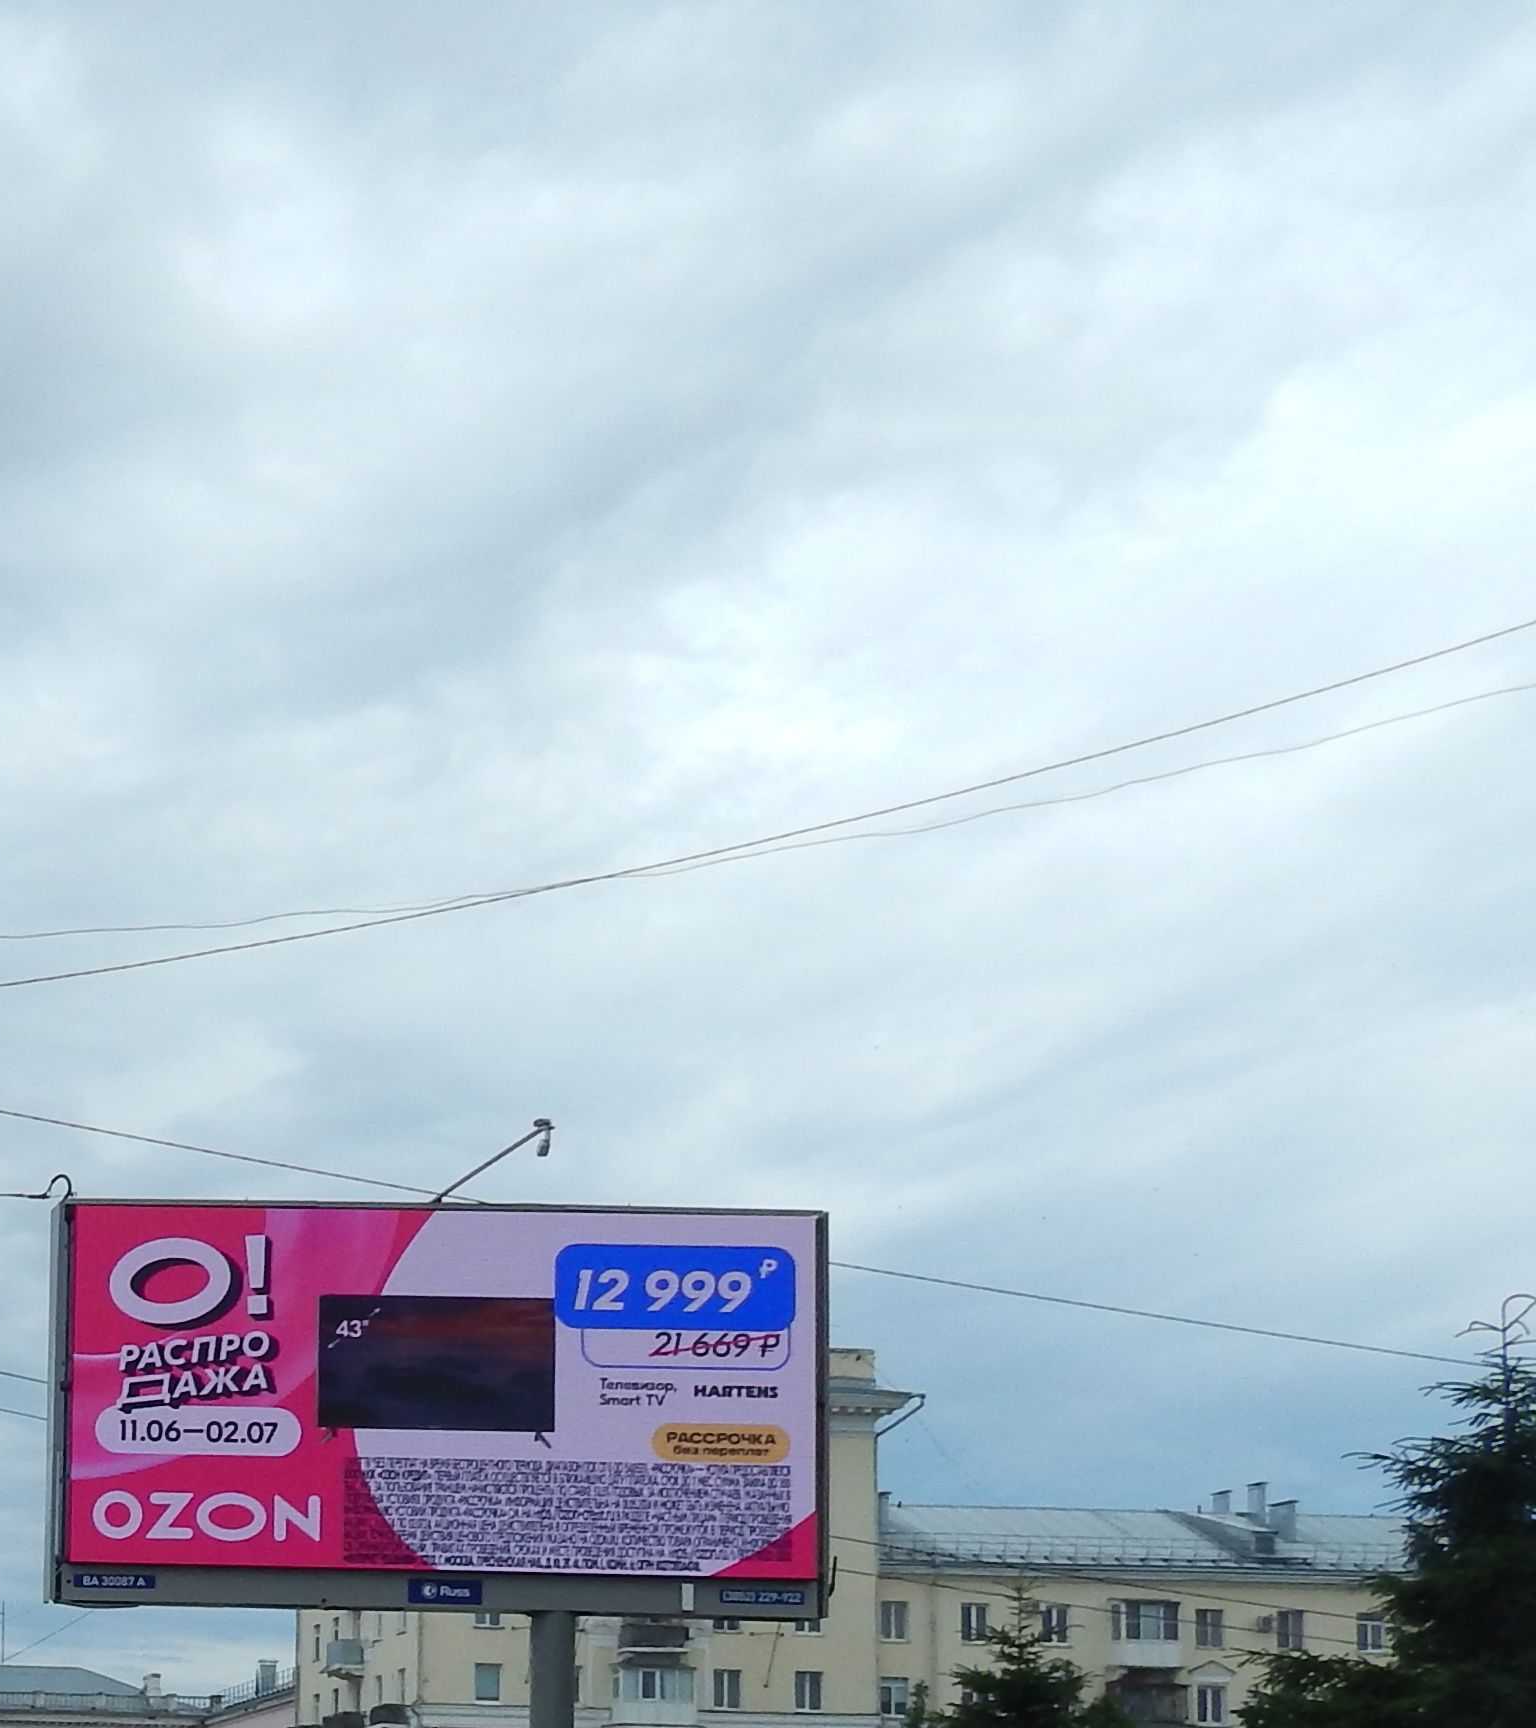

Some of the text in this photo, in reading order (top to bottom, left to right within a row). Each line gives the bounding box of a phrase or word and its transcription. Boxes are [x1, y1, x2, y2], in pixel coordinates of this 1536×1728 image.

[109, 1234, 273, 1327] О!
[574, 1268, 630, 1312] 12
[645, 1269, 752, 1313] 999
[118, 1331, 271, 1372] РАСПРО
[691, 1332, 751, 1358] 669
[116, 1363, 270, 1409] ДАЖА
[599, 1394, 666, 1406] Smart TV
[666, 1431, 776, 1445] РАССРОЧКА
[92, 1490, 322, 1543] OZON
